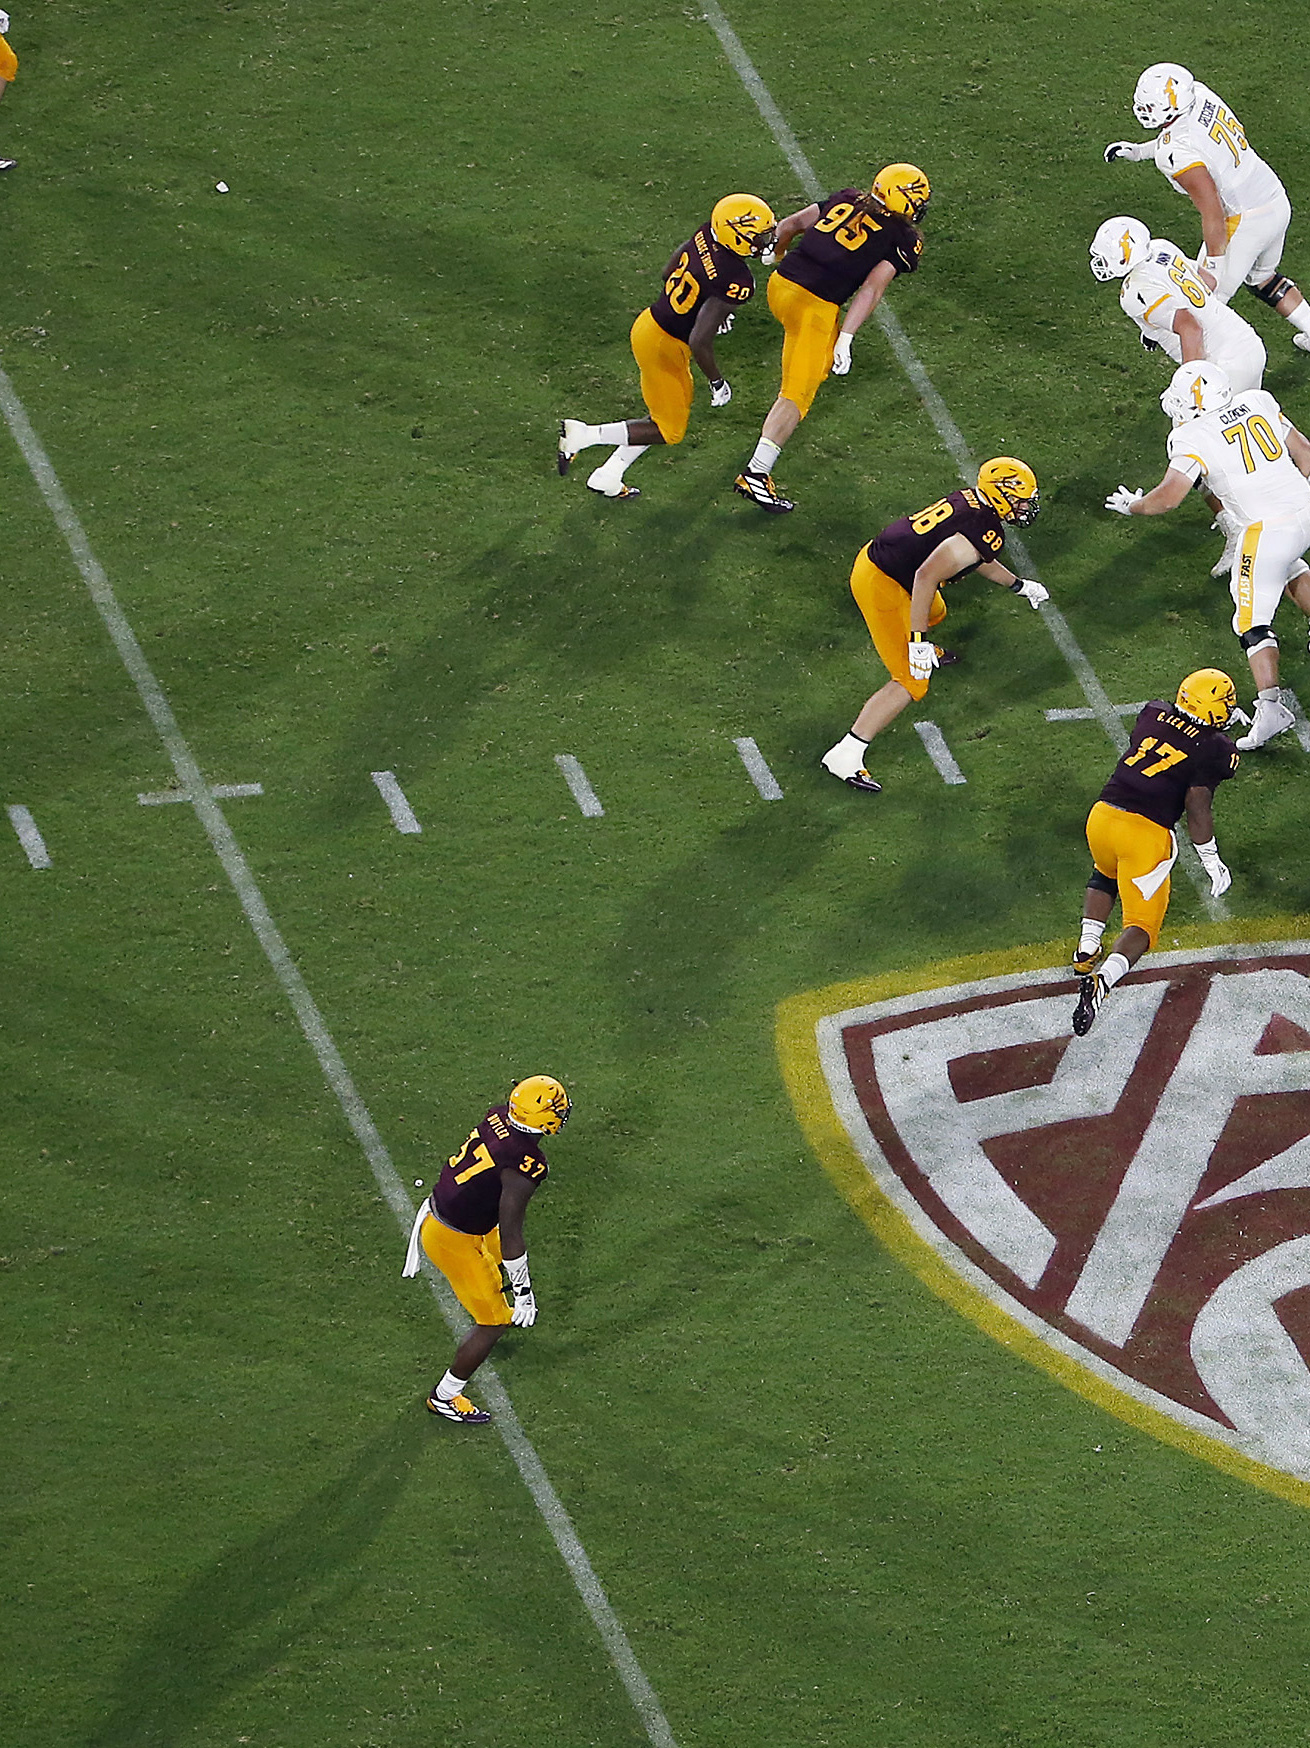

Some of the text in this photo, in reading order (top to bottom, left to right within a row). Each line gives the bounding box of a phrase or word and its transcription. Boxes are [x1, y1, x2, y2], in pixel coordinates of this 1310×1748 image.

[1209, 105, 1247, 168] 75
[814, 203, 882, 251] 95
[665, 252, 700, 314] 20
[726, 283, 750, 300] 20
[1221, 415, 1283, 475] 70
[982, 529, 1003, 551] 98
[1123, 736, 1189, 778] 17
[486, 1113, 511, 1141] BUTLER
[448, 1127, 496, 1186] 37
[518, 1154, 546, 1178] 37
